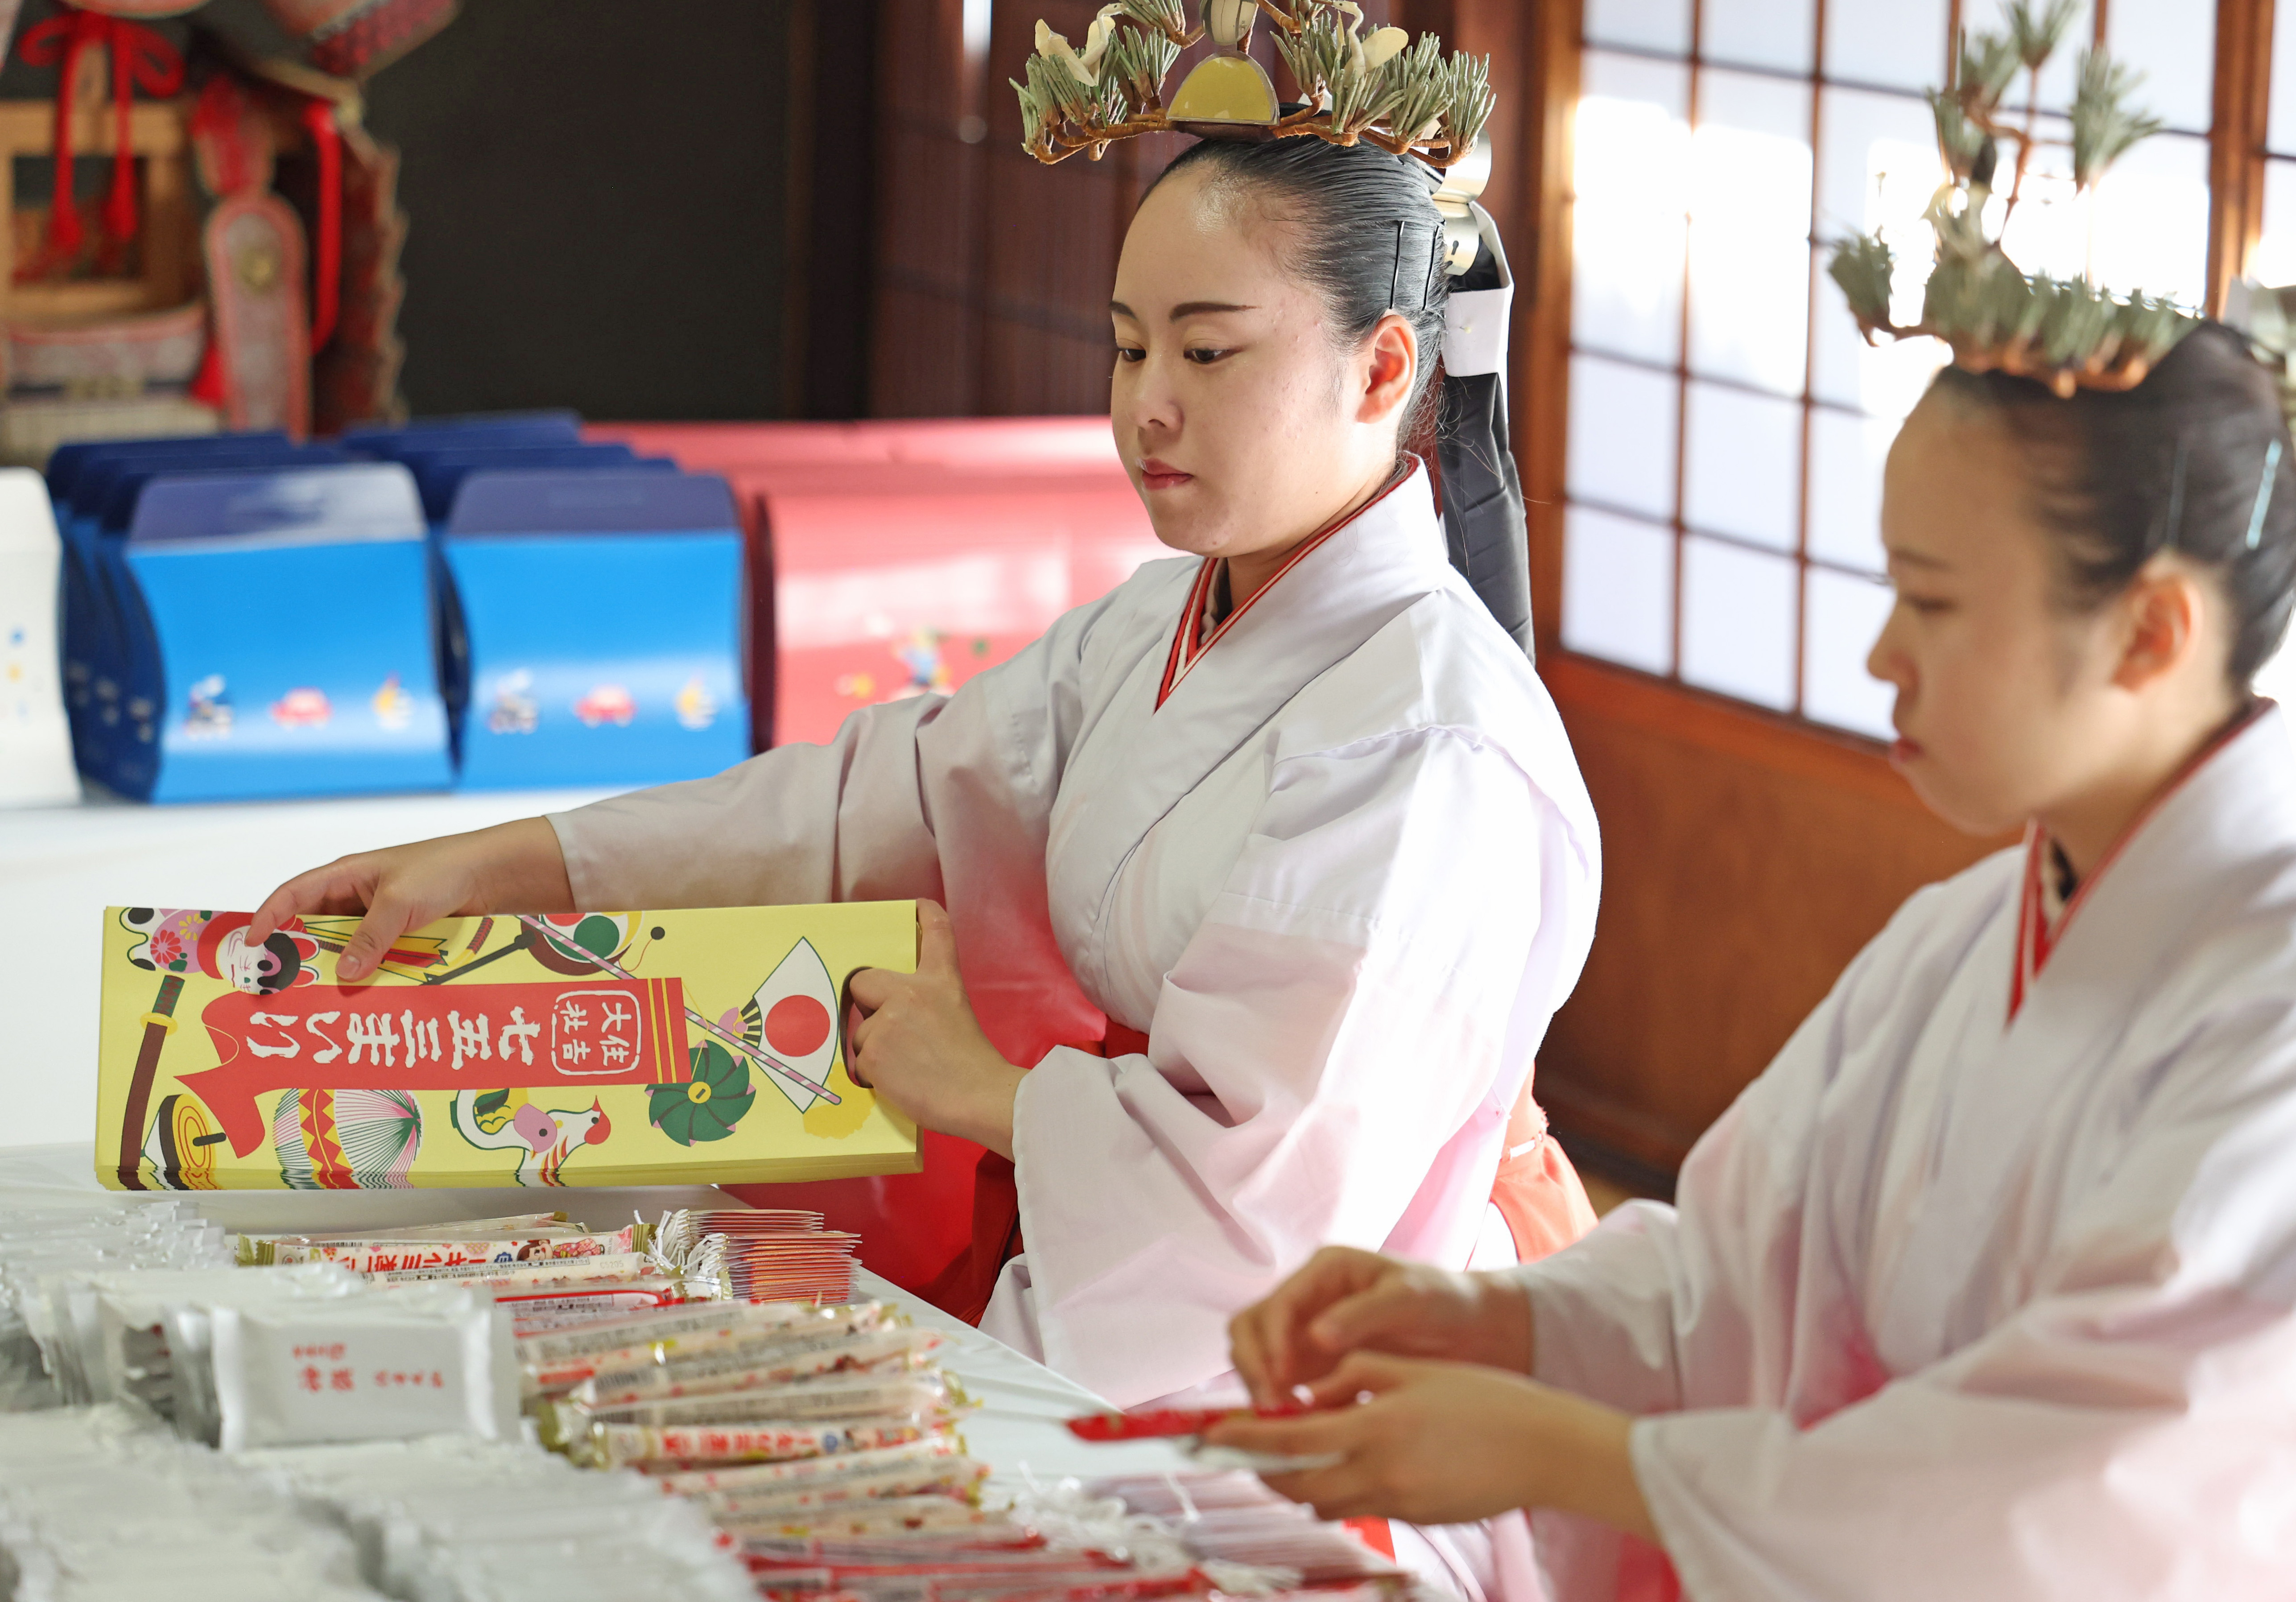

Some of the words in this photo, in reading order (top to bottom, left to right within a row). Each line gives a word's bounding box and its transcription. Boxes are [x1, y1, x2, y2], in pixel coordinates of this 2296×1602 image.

[560, 1000, 632, 1035] 大社
[246, 1006, 541, 1070] 七五三まいり
[562, 1034, 630, 1067] 住吉
